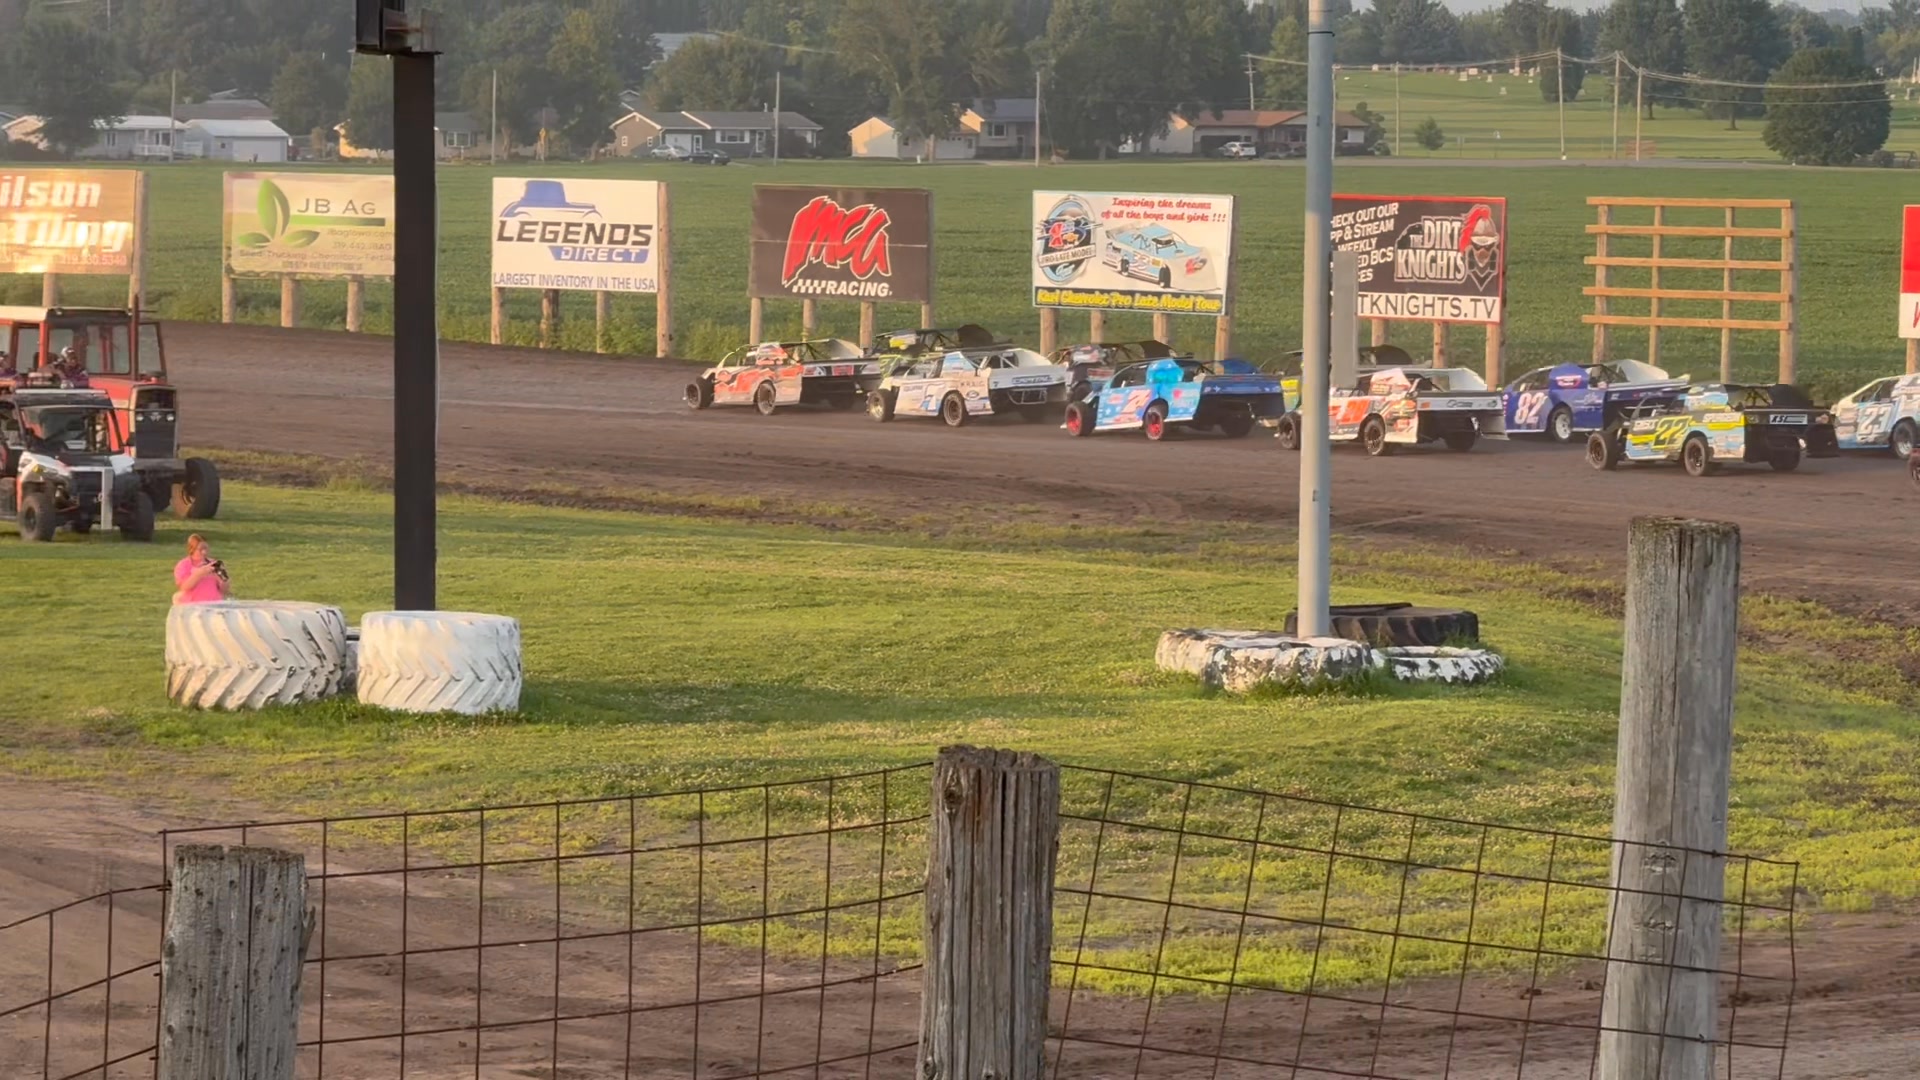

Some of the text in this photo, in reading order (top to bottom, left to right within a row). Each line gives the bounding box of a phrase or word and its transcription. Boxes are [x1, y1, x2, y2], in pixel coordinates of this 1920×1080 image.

[0, 175, 102, 208] ilson
[297, 197, 331, 214] JB
[1157, 199, 1174, 208] the
[1126, 210, 1141, 219] the
[1143, 211, 1164, 222] boys
[1166, 213, 1185, 221] and
[1187, 213, 1209, 223] girls
[1330, 202, 1400, 229] HECK OUT OUR
[496, 220, 653, 246] LEGENDS
[1330, 229, 1343, 243] PP
[1343, 225, 1353, 241] &
[1410, 219, 1462, 250] THE DIRT
[560, 247, 641, 262] DIRECT
[1337, 237, 1378, 253] WEEKLY
[1370, 246, 1394, 266] BCS
[1396, 249, 1466, 280] KNIGHTS
[493, 273, 656, 290] LARGEST INVENTORY IN THE USA
[1358, 294, 1497, 319] TKNIGHTS.TV
[1514, 391, 1548, 425] 82
[1653, 415, 1692, 449] 22
